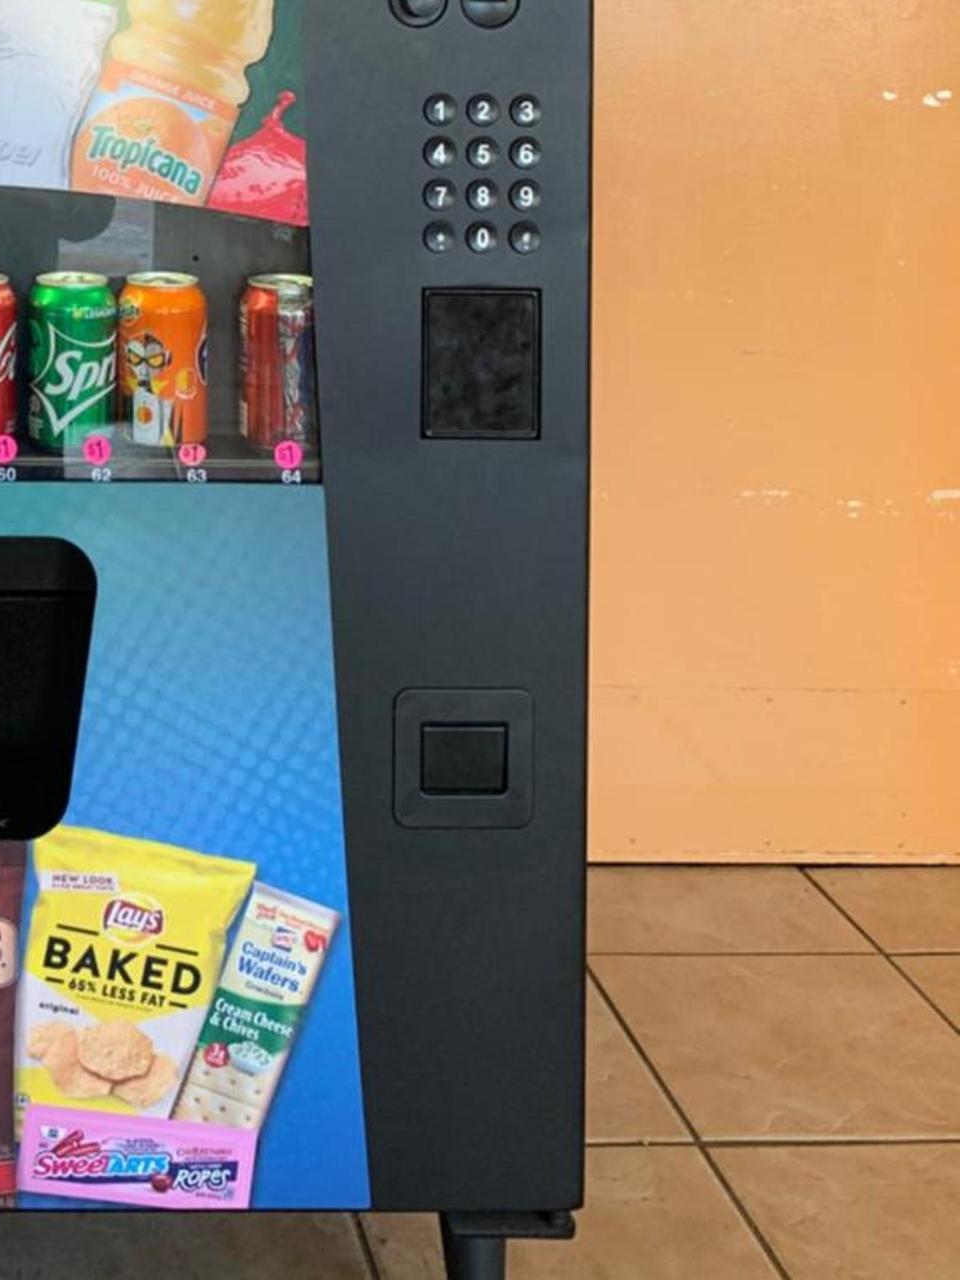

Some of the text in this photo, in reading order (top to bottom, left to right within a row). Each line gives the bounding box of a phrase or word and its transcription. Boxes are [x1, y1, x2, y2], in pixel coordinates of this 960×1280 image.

[434, 100, 445, 122] 1
[477, 101, 490, 120] 2
[520, 101, 534, 122] 3
[88, 124, 203, 197] Tropicana
[432, 143, 446, 164] 4
[477, 144, 490, 164] 5
[519, 143, 534, 164] 6
[434, 186, 447, 207] 7
[477, 186, 490, 206] 8
[519, 186, 534, 207] 9
[477, 228, 489, 249] 0
[91, 468, 112, 482] 62
[186, 469, 207, 483] 63
[281, 470, 302, 484] 64
[52, 873, 115, 886] NEW LOOK
[43, 935, 202, 996] BAKED
[241, 940, 308, 976] Captain's
[238, 956, 300, 994] Wafers
[68, 978, 97, 993] 65%
[102, 984, 136, 1003] LESS
[140, 991, 167, 1008] FAT
[215, 997, 294, 1038] Cream Cheese
[223, 1016, 260, 1041] Chives
